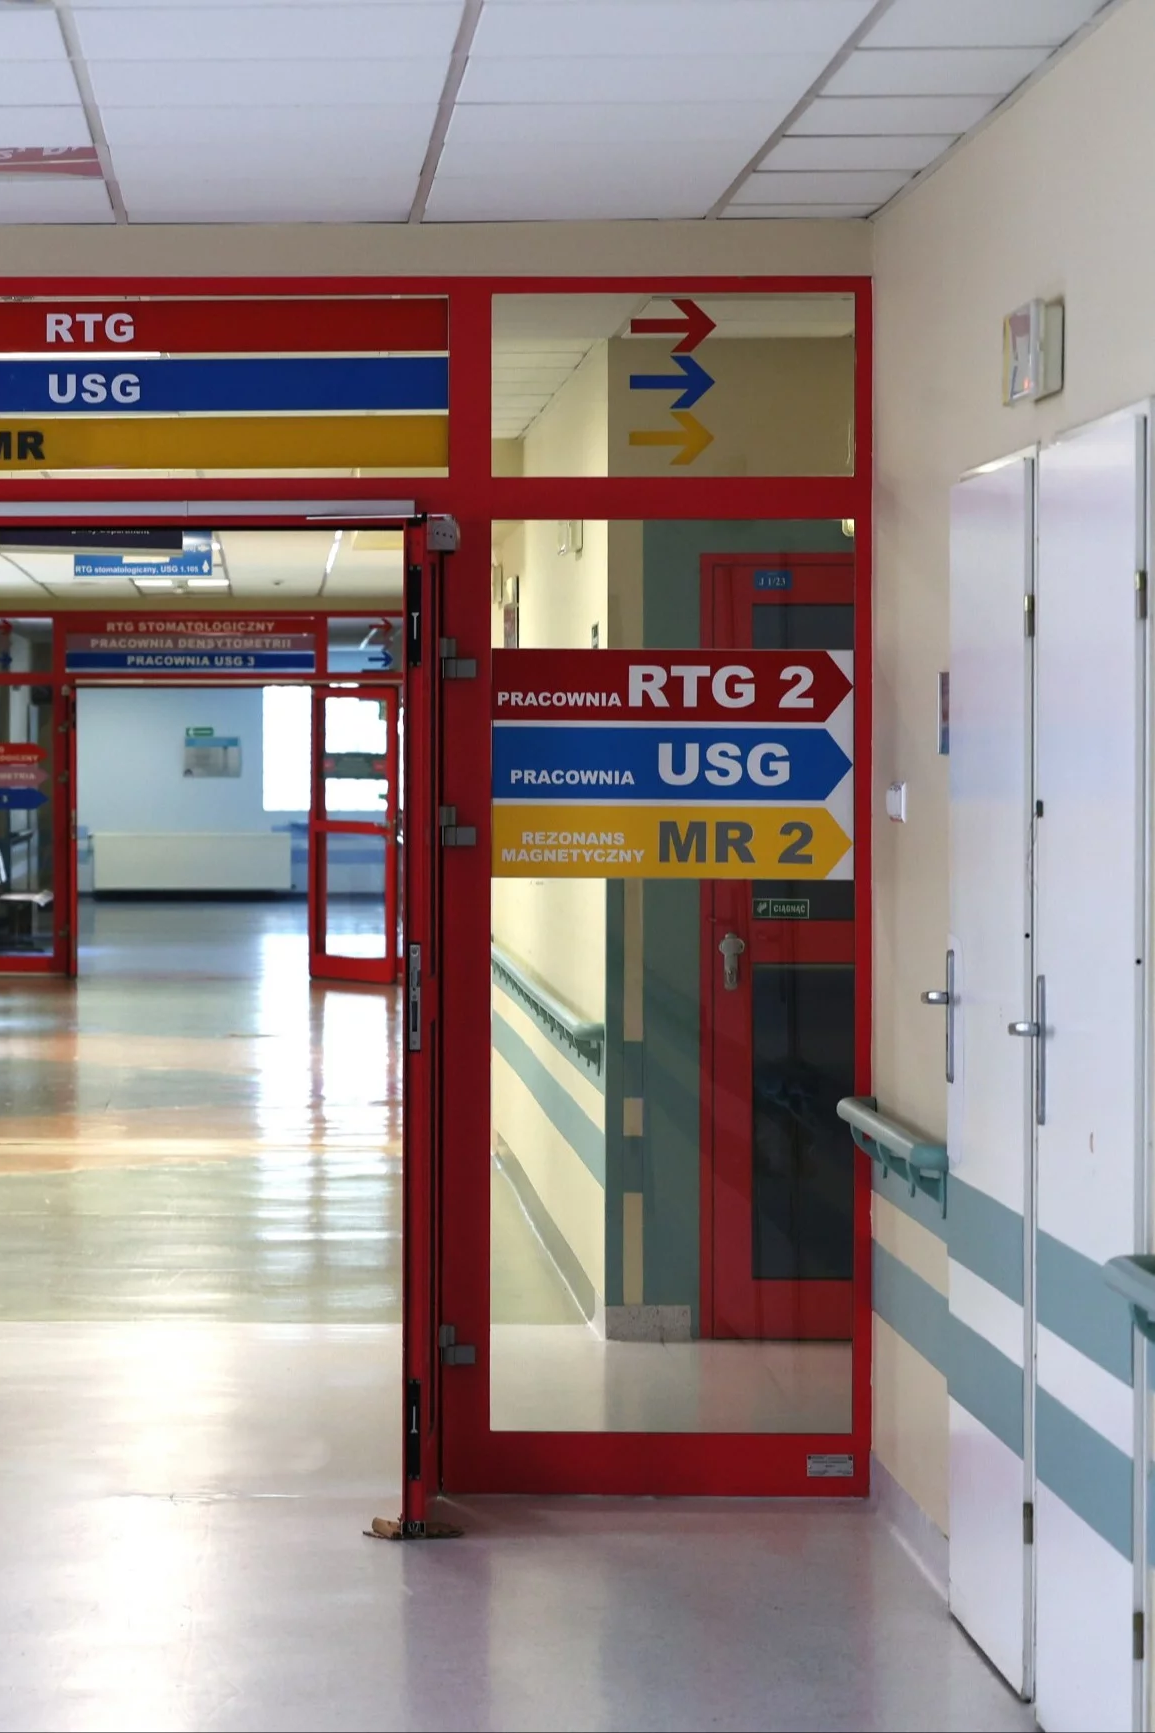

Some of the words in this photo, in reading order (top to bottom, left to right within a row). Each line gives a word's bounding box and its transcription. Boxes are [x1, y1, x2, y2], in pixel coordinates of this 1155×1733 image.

[45, 313, 136, 343] RTG
[47, 373, 142, 404] USG
[75, 565, 93, 573] RTG
[160, 565, 179, 573] USG
[106, 622, 134, 632] RTG
[138, 622, 276, 632] STOMATOLOGICZNY
[90, 638, 173, 649] PRACOWNIA
[178, 638, 292, 649] DENSYTOMETRII
[126, 656, 210, 667] PRACOWNIA
[214, 656, 244, 667] USG
[247, 656, 255, 667] 3
[497, 692, 622, 707] PRACOWNIA
[627, 665, 756, 708] RTG
[778, 665, 814, 708] 2
[510, 769, 635, 785] PRACOWNIA
[658, 742, 790, 786] USG
[521, 832, 625, 845] REZONANS
[658, 820, 755, 863] MR
[777, 821, 813, 864] 2
[501, 849, 644, 862] MAGNETYCZNY
